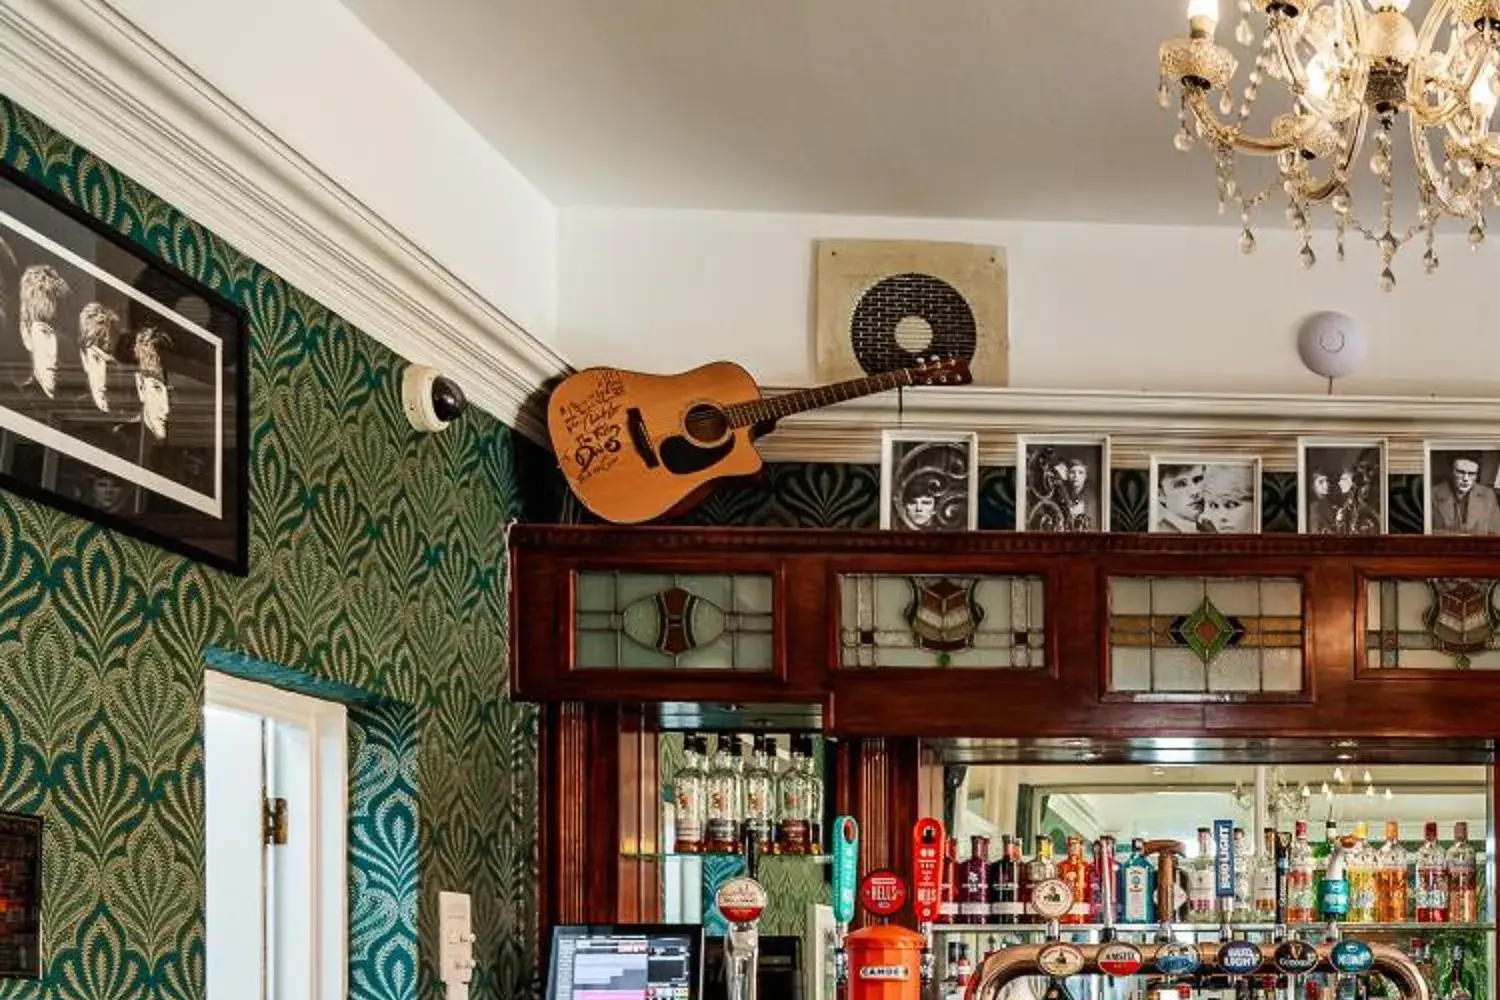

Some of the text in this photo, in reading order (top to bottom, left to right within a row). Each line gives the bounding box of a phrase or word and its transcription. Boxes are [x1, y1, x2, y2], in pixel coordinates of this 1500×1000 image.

[871, 885, 897, 901] HELLS
[1105, 951, 1136, 961] AMSTEL
[1227, 947, 1254, 957] BUD
[1224, 957, 1259, 967] LIGHT
